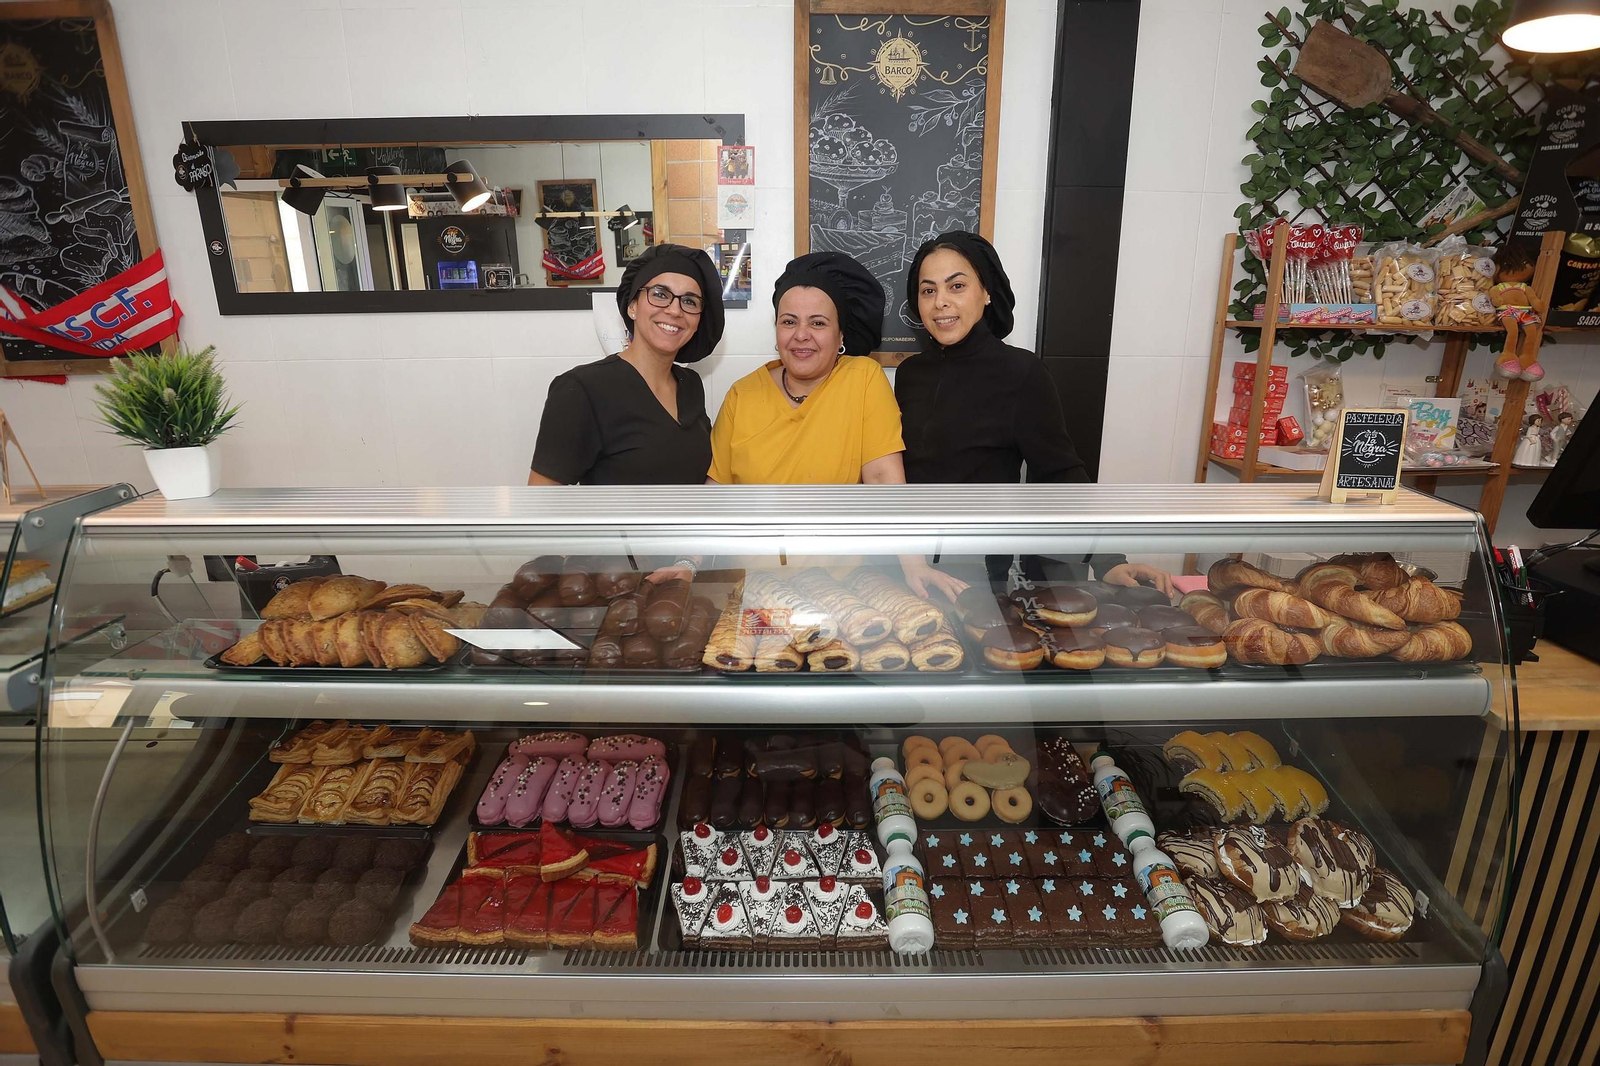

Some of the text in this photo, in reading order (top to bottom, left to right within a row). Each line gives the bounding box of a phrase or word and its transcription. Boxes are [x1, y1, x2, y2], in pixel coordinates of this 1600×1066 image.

[885, 66, 913, 75] BARCO
[1556, 104, 1586, 116] CORTIJO
[1529, 194, 1558, 204] CORTIJO
[1521, 208, 1557, 218] del Olivar
[1408, 401, 1452, 431] Boy
[1365, 436, 1377, 446] La
[1353, 440, 1387, 458] Negra
[1338, 475, 1395, 488] ARTESANAL
